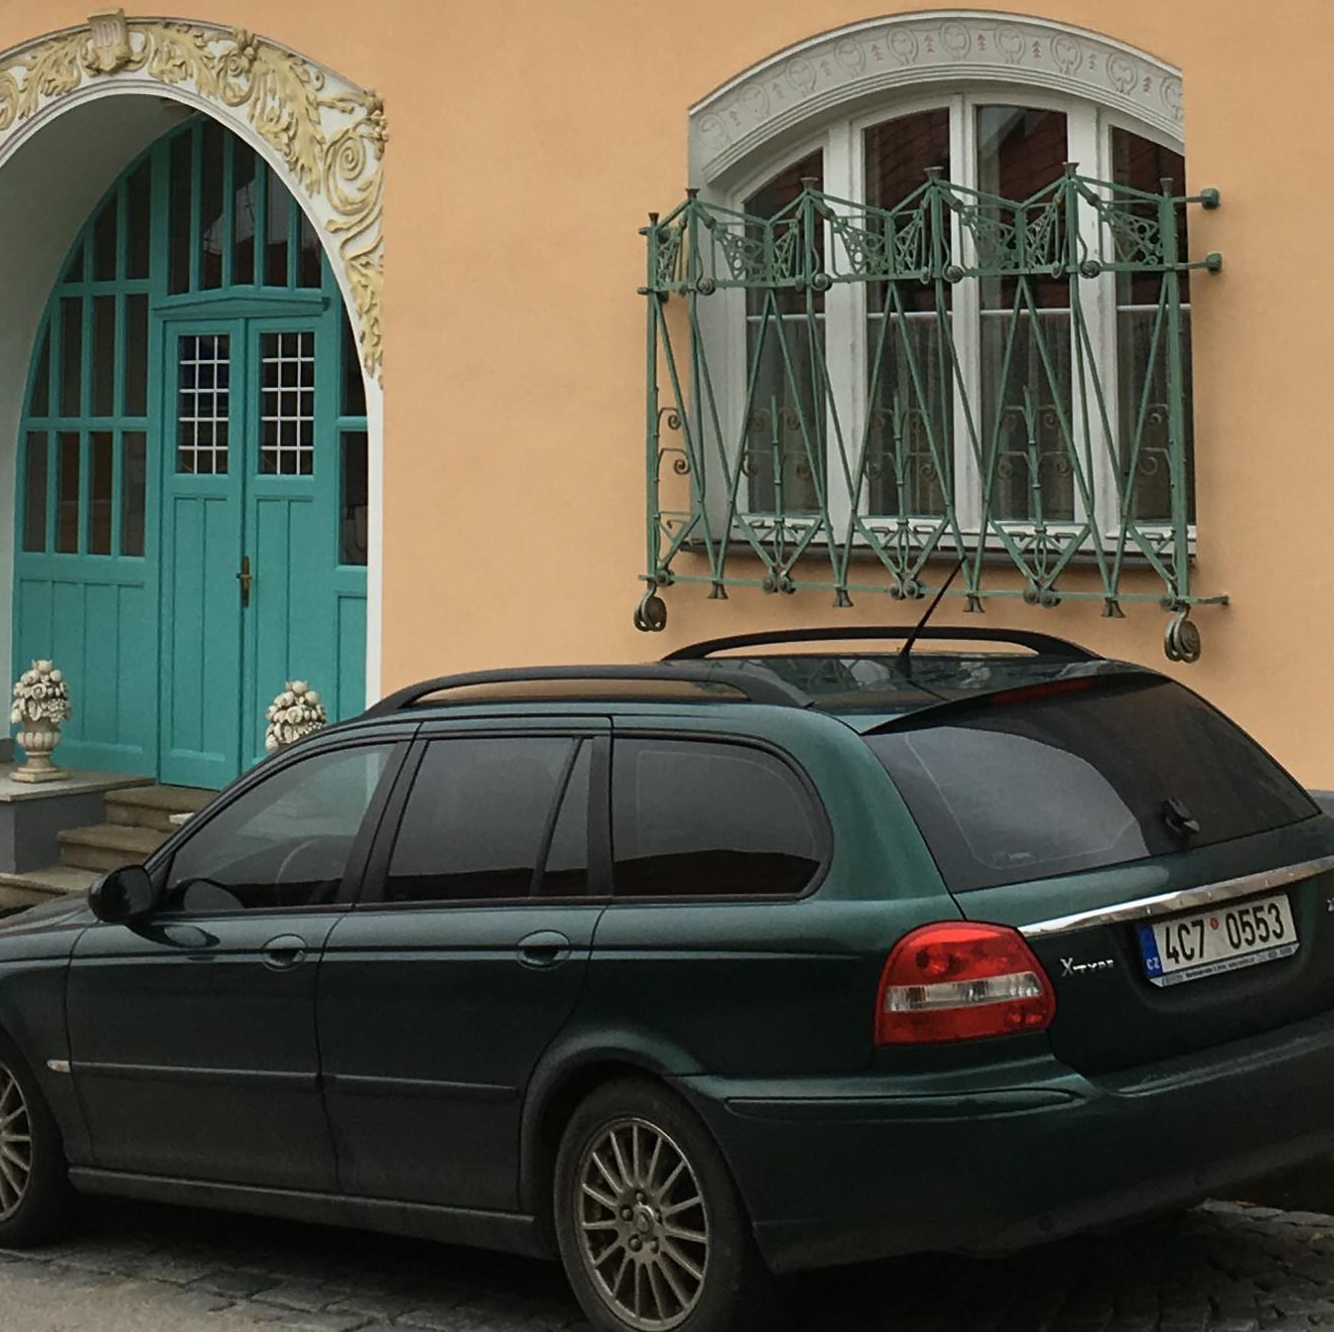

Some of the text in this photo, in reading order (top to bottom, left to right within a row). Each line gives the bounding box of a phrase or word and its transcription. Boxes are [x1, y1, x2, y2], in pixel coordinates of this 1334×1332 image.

[1164, 903, 1285, 964] 4C7 0553
[1146, 957, 1162, 971] CZ
